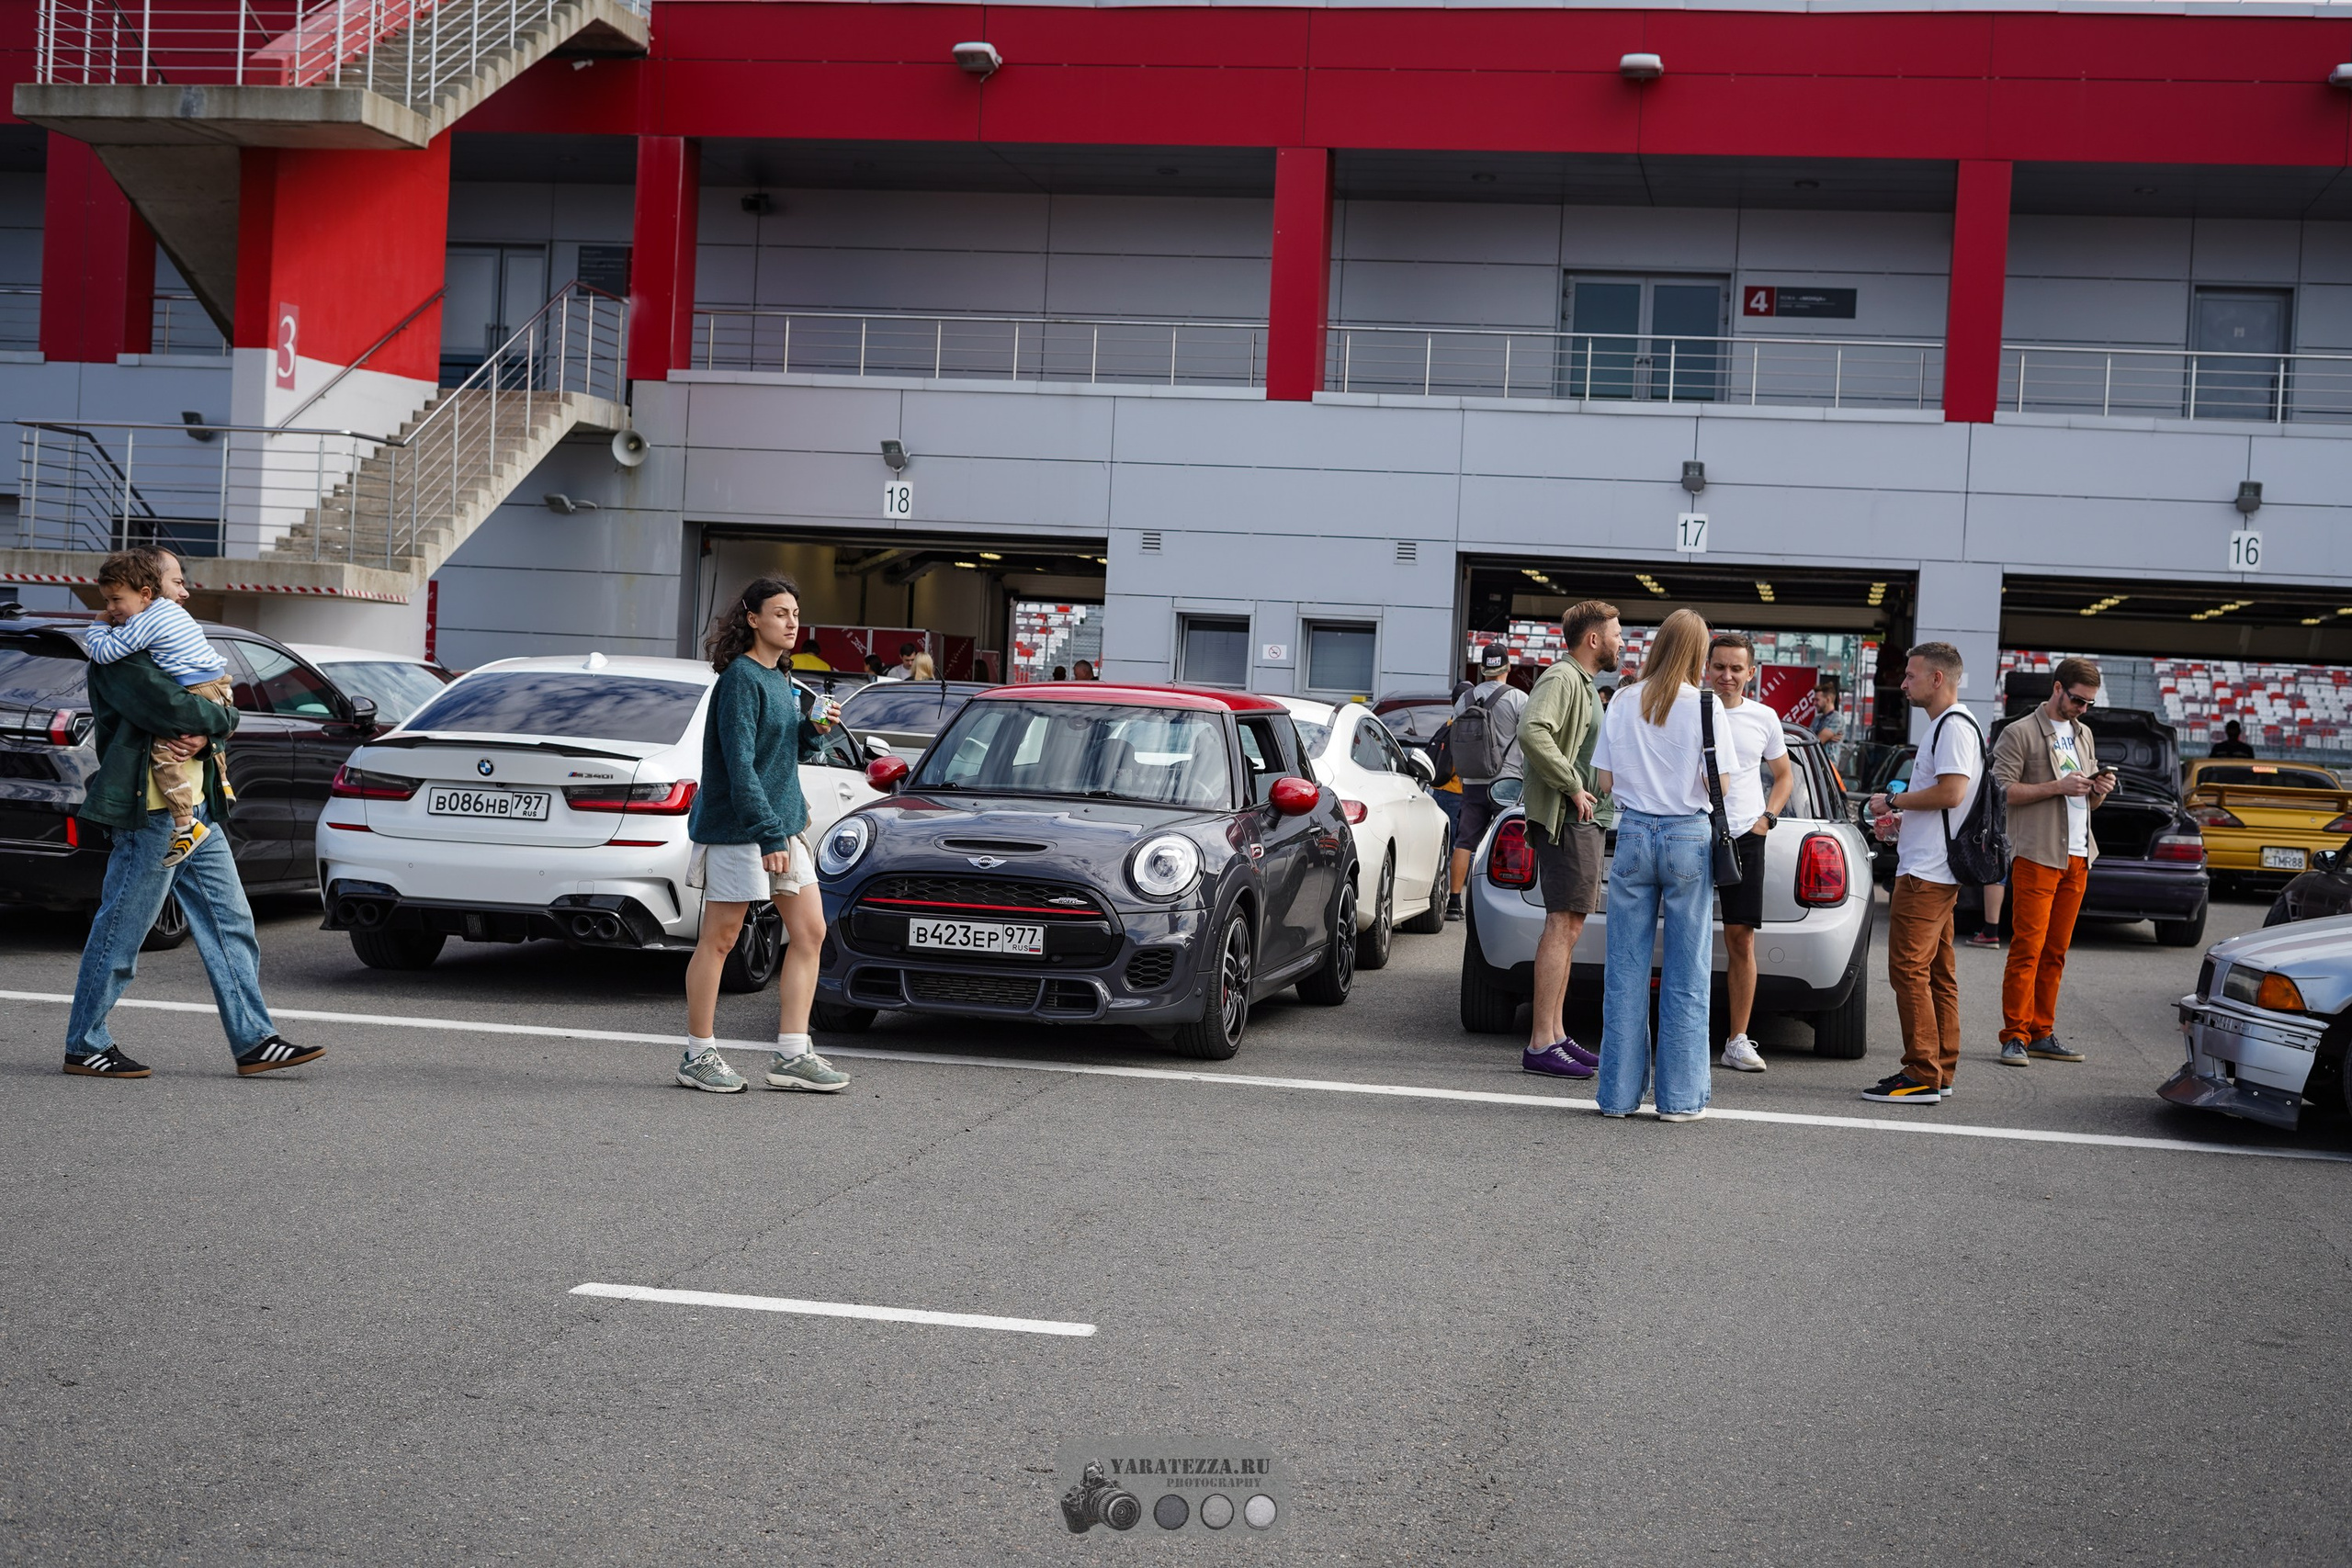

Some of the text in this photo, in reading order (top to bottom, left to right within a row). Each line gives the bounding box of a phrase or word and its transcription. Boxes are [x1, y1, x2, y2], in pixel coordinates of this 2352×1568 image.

[1749, 290, 1769, 312] 4
[277, 315, 296, 378] 3
[887, 487, 910, 513] 18
[1680, 519, 1705, 547] 17
[2233, 536, 2259, 565] 16
[1706, 761, 1724, 817] BURBERRY
[514, 795, 543, 811] 797
[1004, 927, 1038, 945] 977
[1012, 943, 1029, 952] RUS
